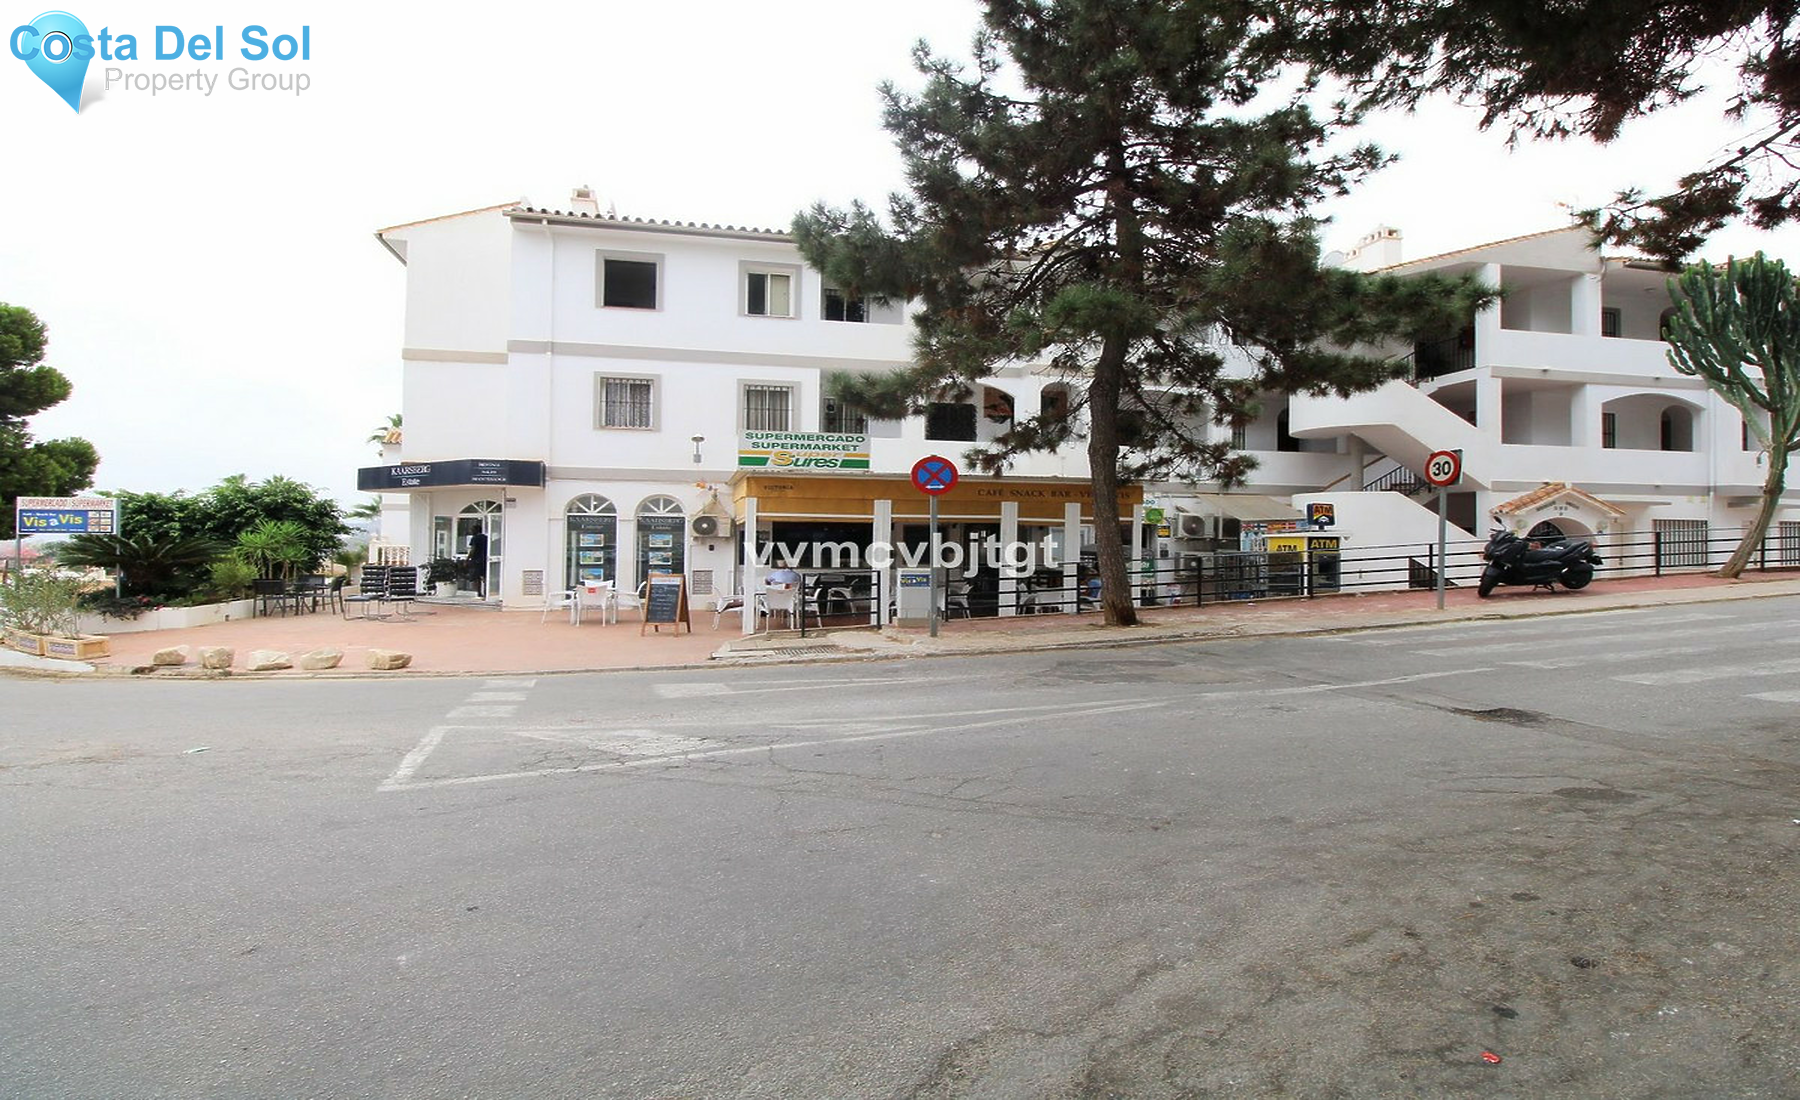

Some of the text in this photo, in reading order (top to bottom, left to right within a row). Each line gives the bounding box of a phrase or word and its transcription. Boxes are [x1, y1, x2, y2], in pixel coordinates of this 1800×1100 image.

[745, 431, 866, 443] SUPERMERCADO
[751, 441, 860, 452] SUPERMARKET
[772, 450, 840, 468] Sures
[1432, 460, 1452, 477] 30
[1009, 489, 1046, 498] SNACK
[1313, 504, 1334, 515] ATM
[22, 516, 48, 527] Vis
[59, 513, 84, 525] Vis
[1310, 539, 1338, 549] ATM
